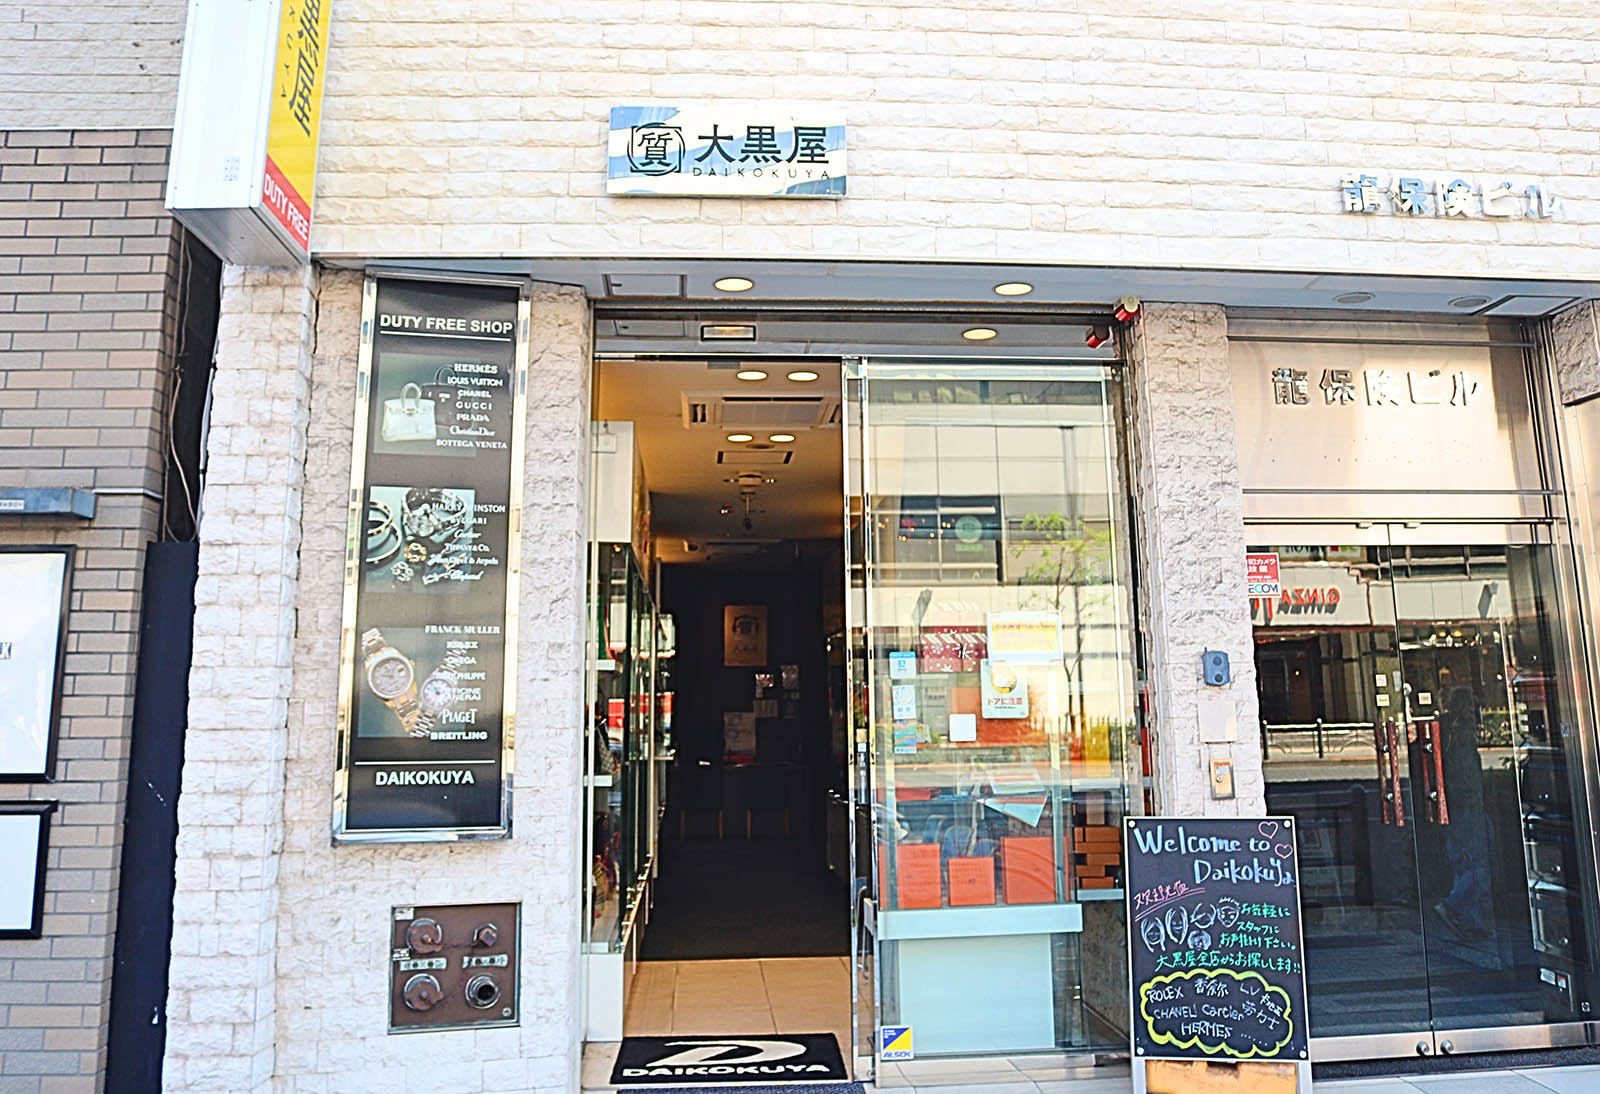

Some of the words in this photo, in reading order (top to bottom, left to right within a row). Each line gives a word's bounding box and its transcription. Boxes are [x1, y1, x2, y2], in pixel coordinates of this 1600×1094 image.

[637, 131, 673, 168] 質
[694, 124, 829, 165] 大黒屋
[692, 167, 830, 180] DAIKOKUYA
[1340, 173, 1562, 219] 龍保険ビル
[264, 173, 288, 215] DUTY
[287, 201, 309, 241] FREE
[380, 314, 422, 328] DUTY
[426, 317, 467, 331] FREE
[470, 320, 513, 334] SHOP
[447, 376, 469, 385] LOUIS
[470, 378, 503, 386] VUITTON
[457, 389, 492, 398] CHANEL
[455, 401, 493, 410] GUCCI
[456, 413, 490, 422] PRADA
[436, 439, 474, 447] BOTTEGA
[475, 441, 508, 449] VENETA
[1247, 583, 1279, 594] ECOM
[442, 708, 478, 724] PIAGET
[430, 731, 488, 740] BREITLING
[375, 770, 475, 786] DAIKOKUYA
[1133, 824, 1242, 855] Welcome
[1248, 837, 1271, 852] to
[1240, 902, 1291, 919] お気軽に
[1236, 920, 1280, 936] スタッフに
[1146, 985, 1184, 1004] ROLEX
[1239, 983, 1261, 997] LV
[1181, 1020, 1233, 1039] HERMES
[622, 1063, 831, 1078] DAIKOKUYA
